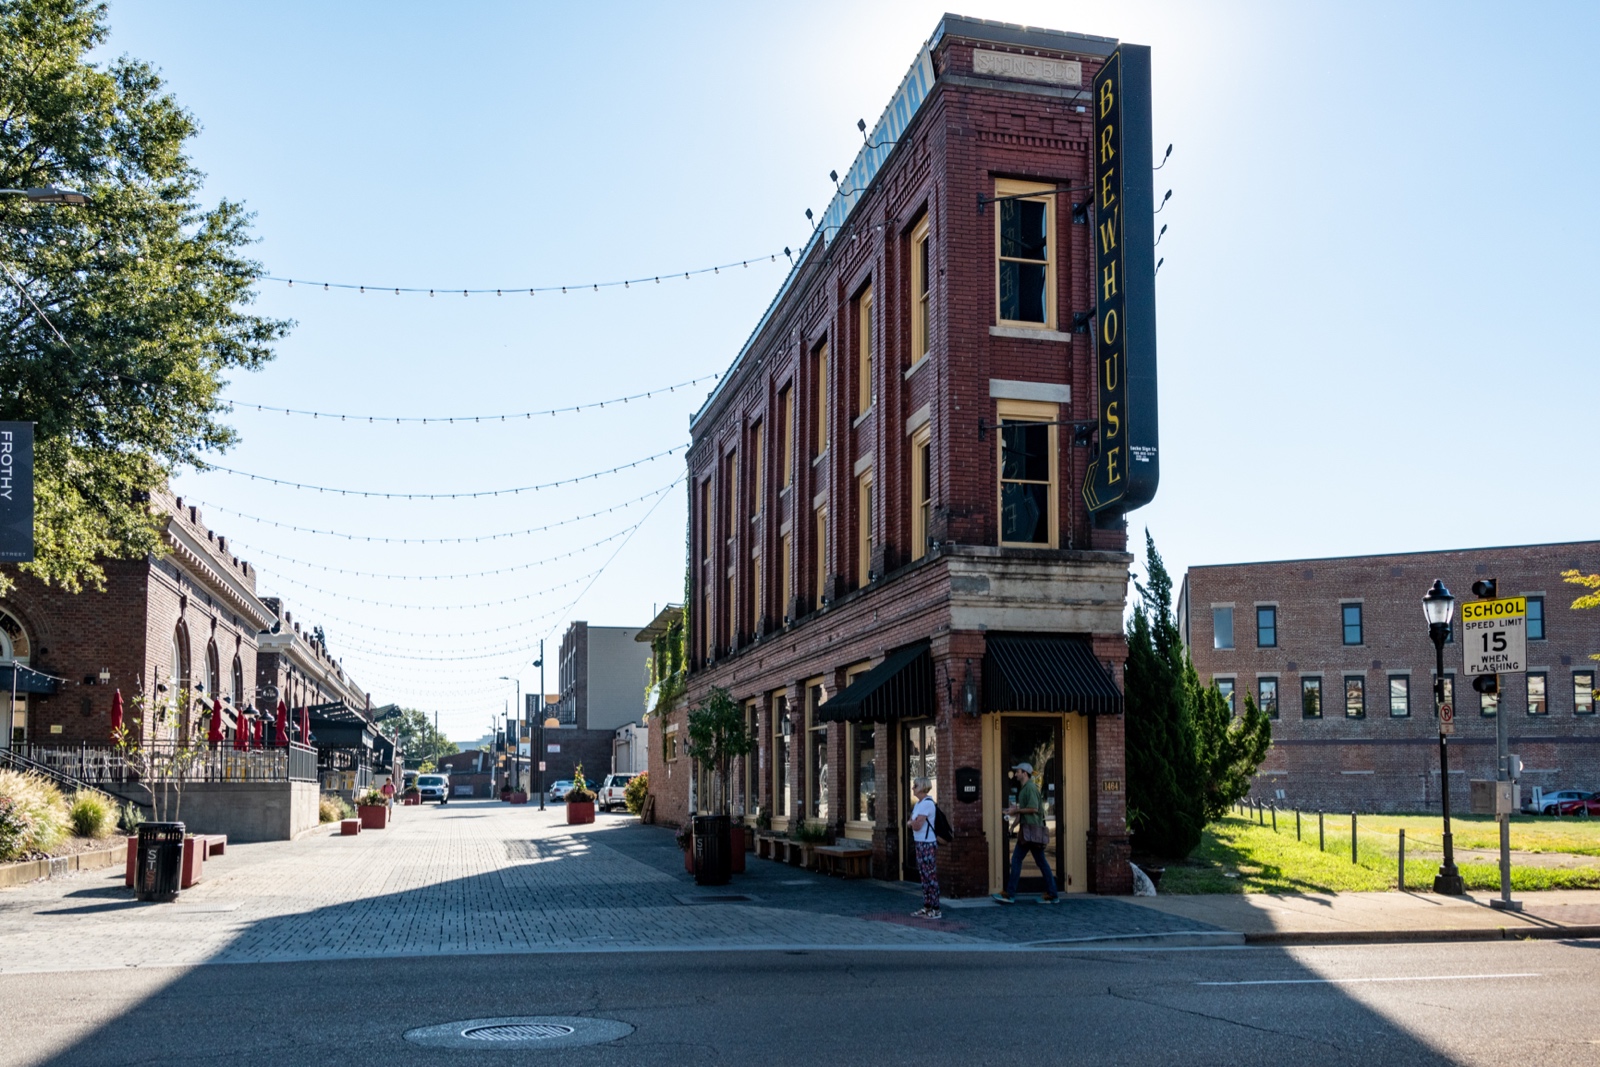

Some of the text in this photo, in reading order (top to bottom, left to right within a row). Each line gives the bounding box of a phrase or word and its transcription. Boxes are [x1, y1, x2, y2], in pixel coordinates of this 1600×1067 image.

[1099, 78, 1121, 485] BREWHOUSE
[1, 431, 13, 501] FROTHY
[1464, 601, 1524, 618] SCHOOL
[1465, 618, 1523, 630] SPEED LIMIT
[1482, 631, 1507, 653] 15
[1481, 654, 1508, 663] WHEN
[1470, 662, 1519, 673] FLASHING
